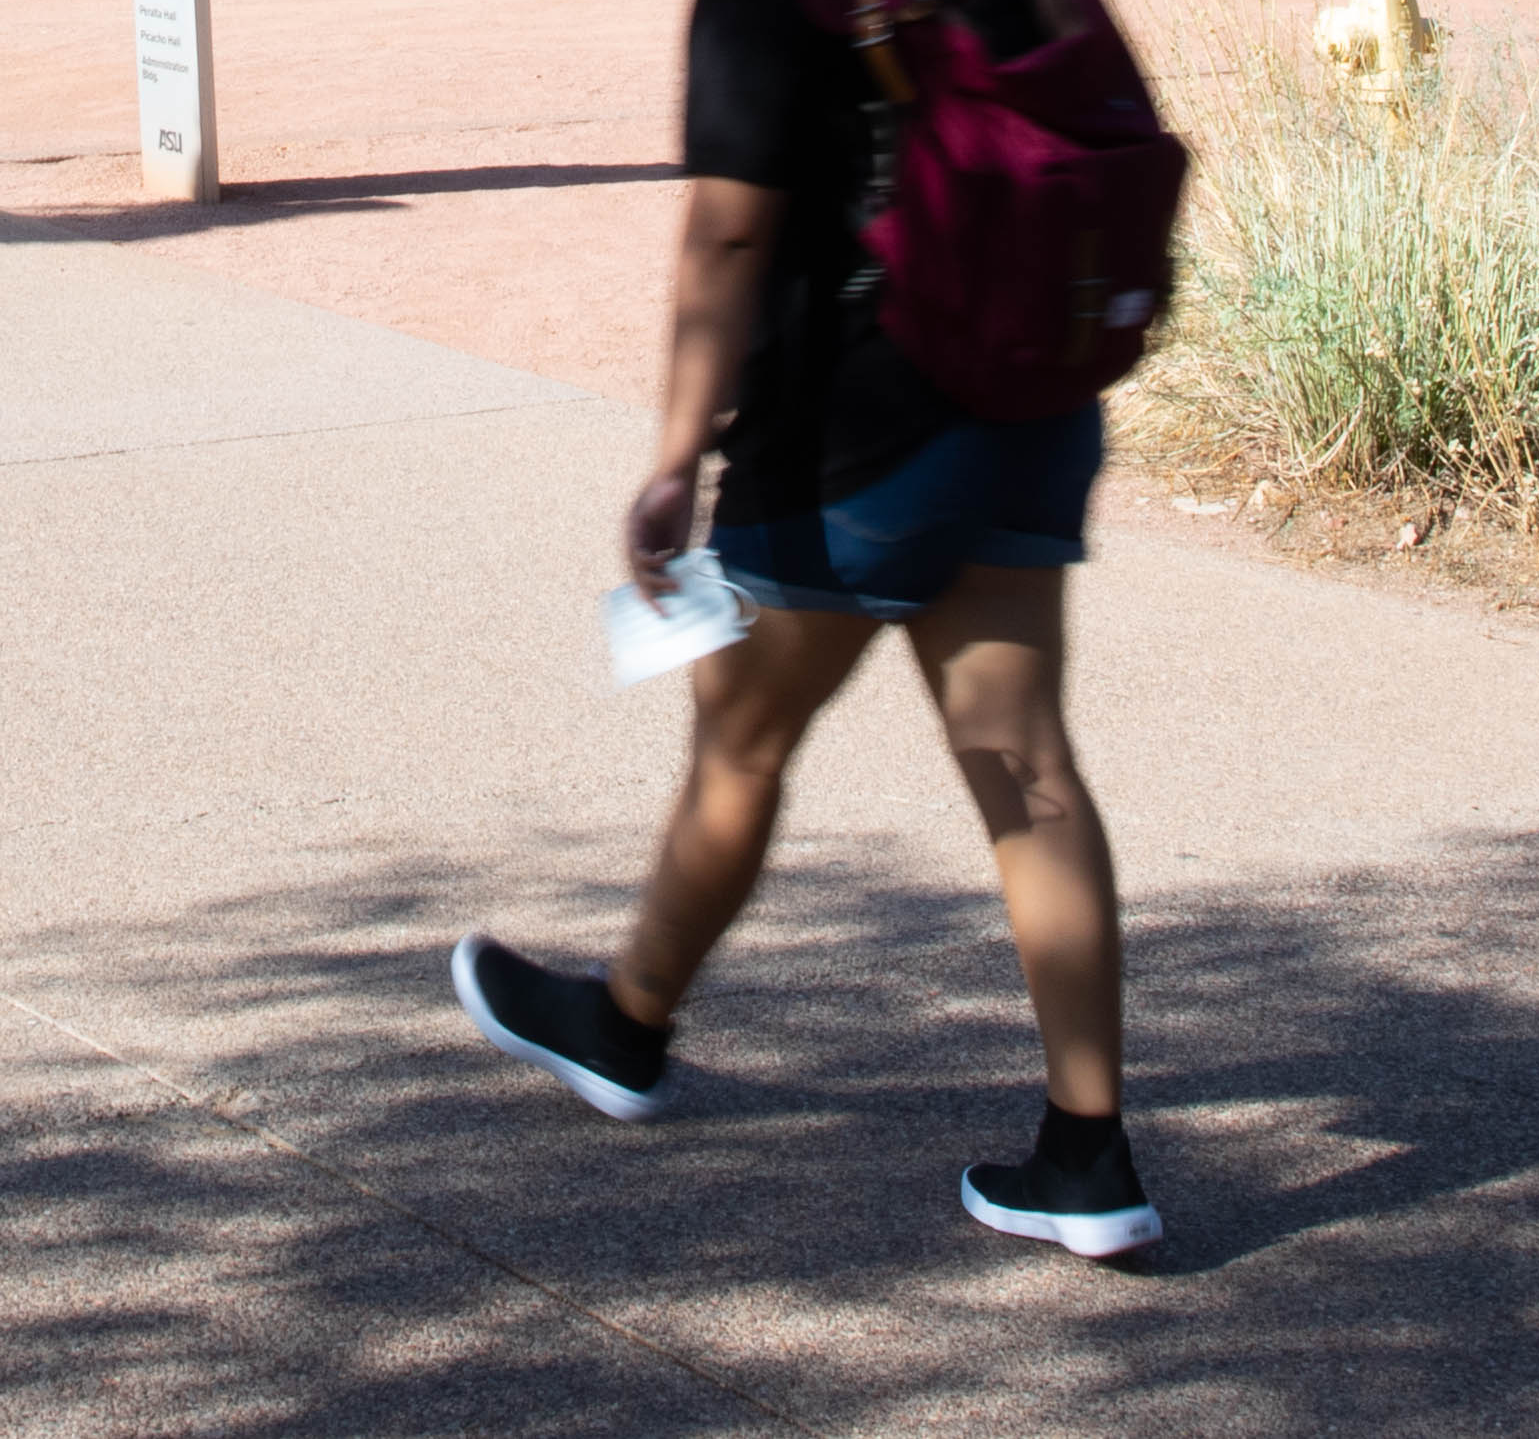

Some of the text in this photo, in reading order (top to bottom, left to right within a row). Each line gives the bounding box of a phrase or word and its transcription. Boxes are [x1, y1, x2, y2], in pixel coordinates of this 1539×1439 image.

[139, 4, 177, 21] Peralta Hall
[140, 29, 181, 47] Picacho Hall
[158, 128, 183, 154] ASU
